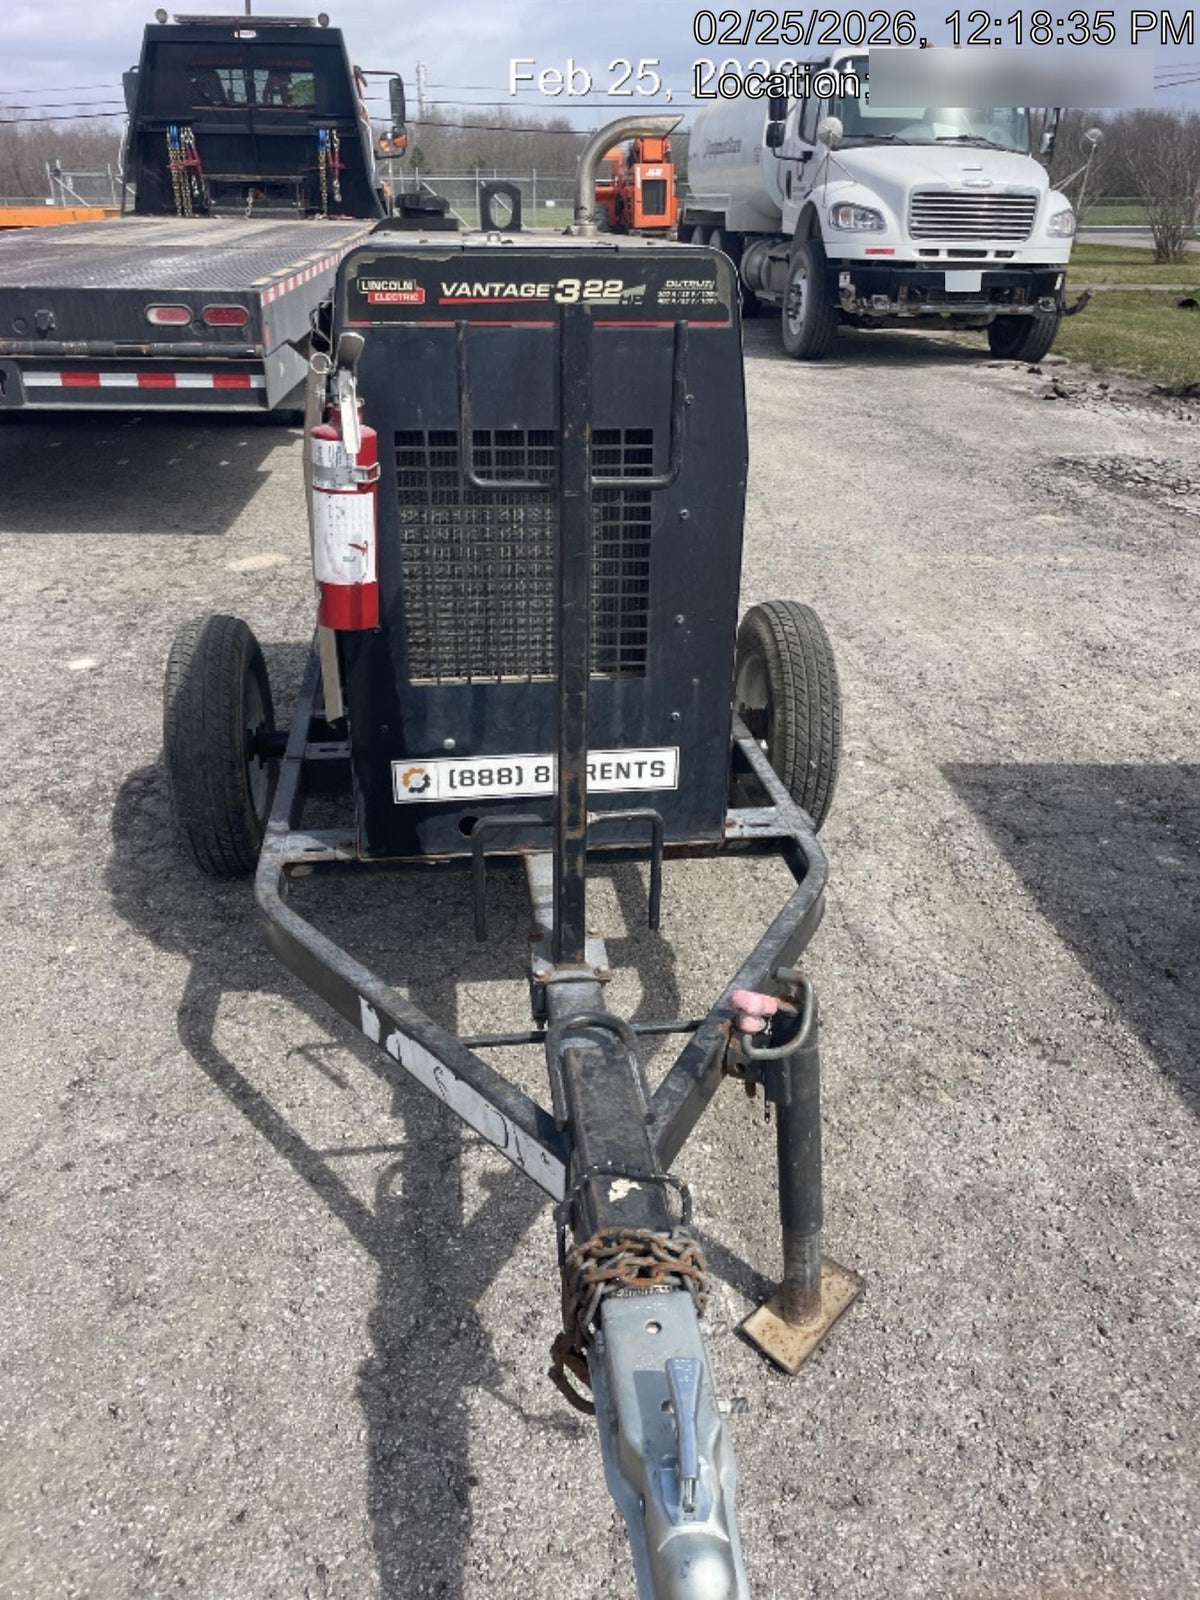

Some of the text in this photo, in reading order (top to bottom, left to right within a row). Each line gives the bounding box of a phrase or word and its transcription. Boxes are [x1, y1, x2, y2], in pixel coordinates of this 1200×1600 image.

[361, 280, 413, 291] LINCOLN
[440, 278, 624, 304] VANTAGE 322
[374, 293, 419, 302] ELECTRIC
[449, 764, 524, 790] (888)
